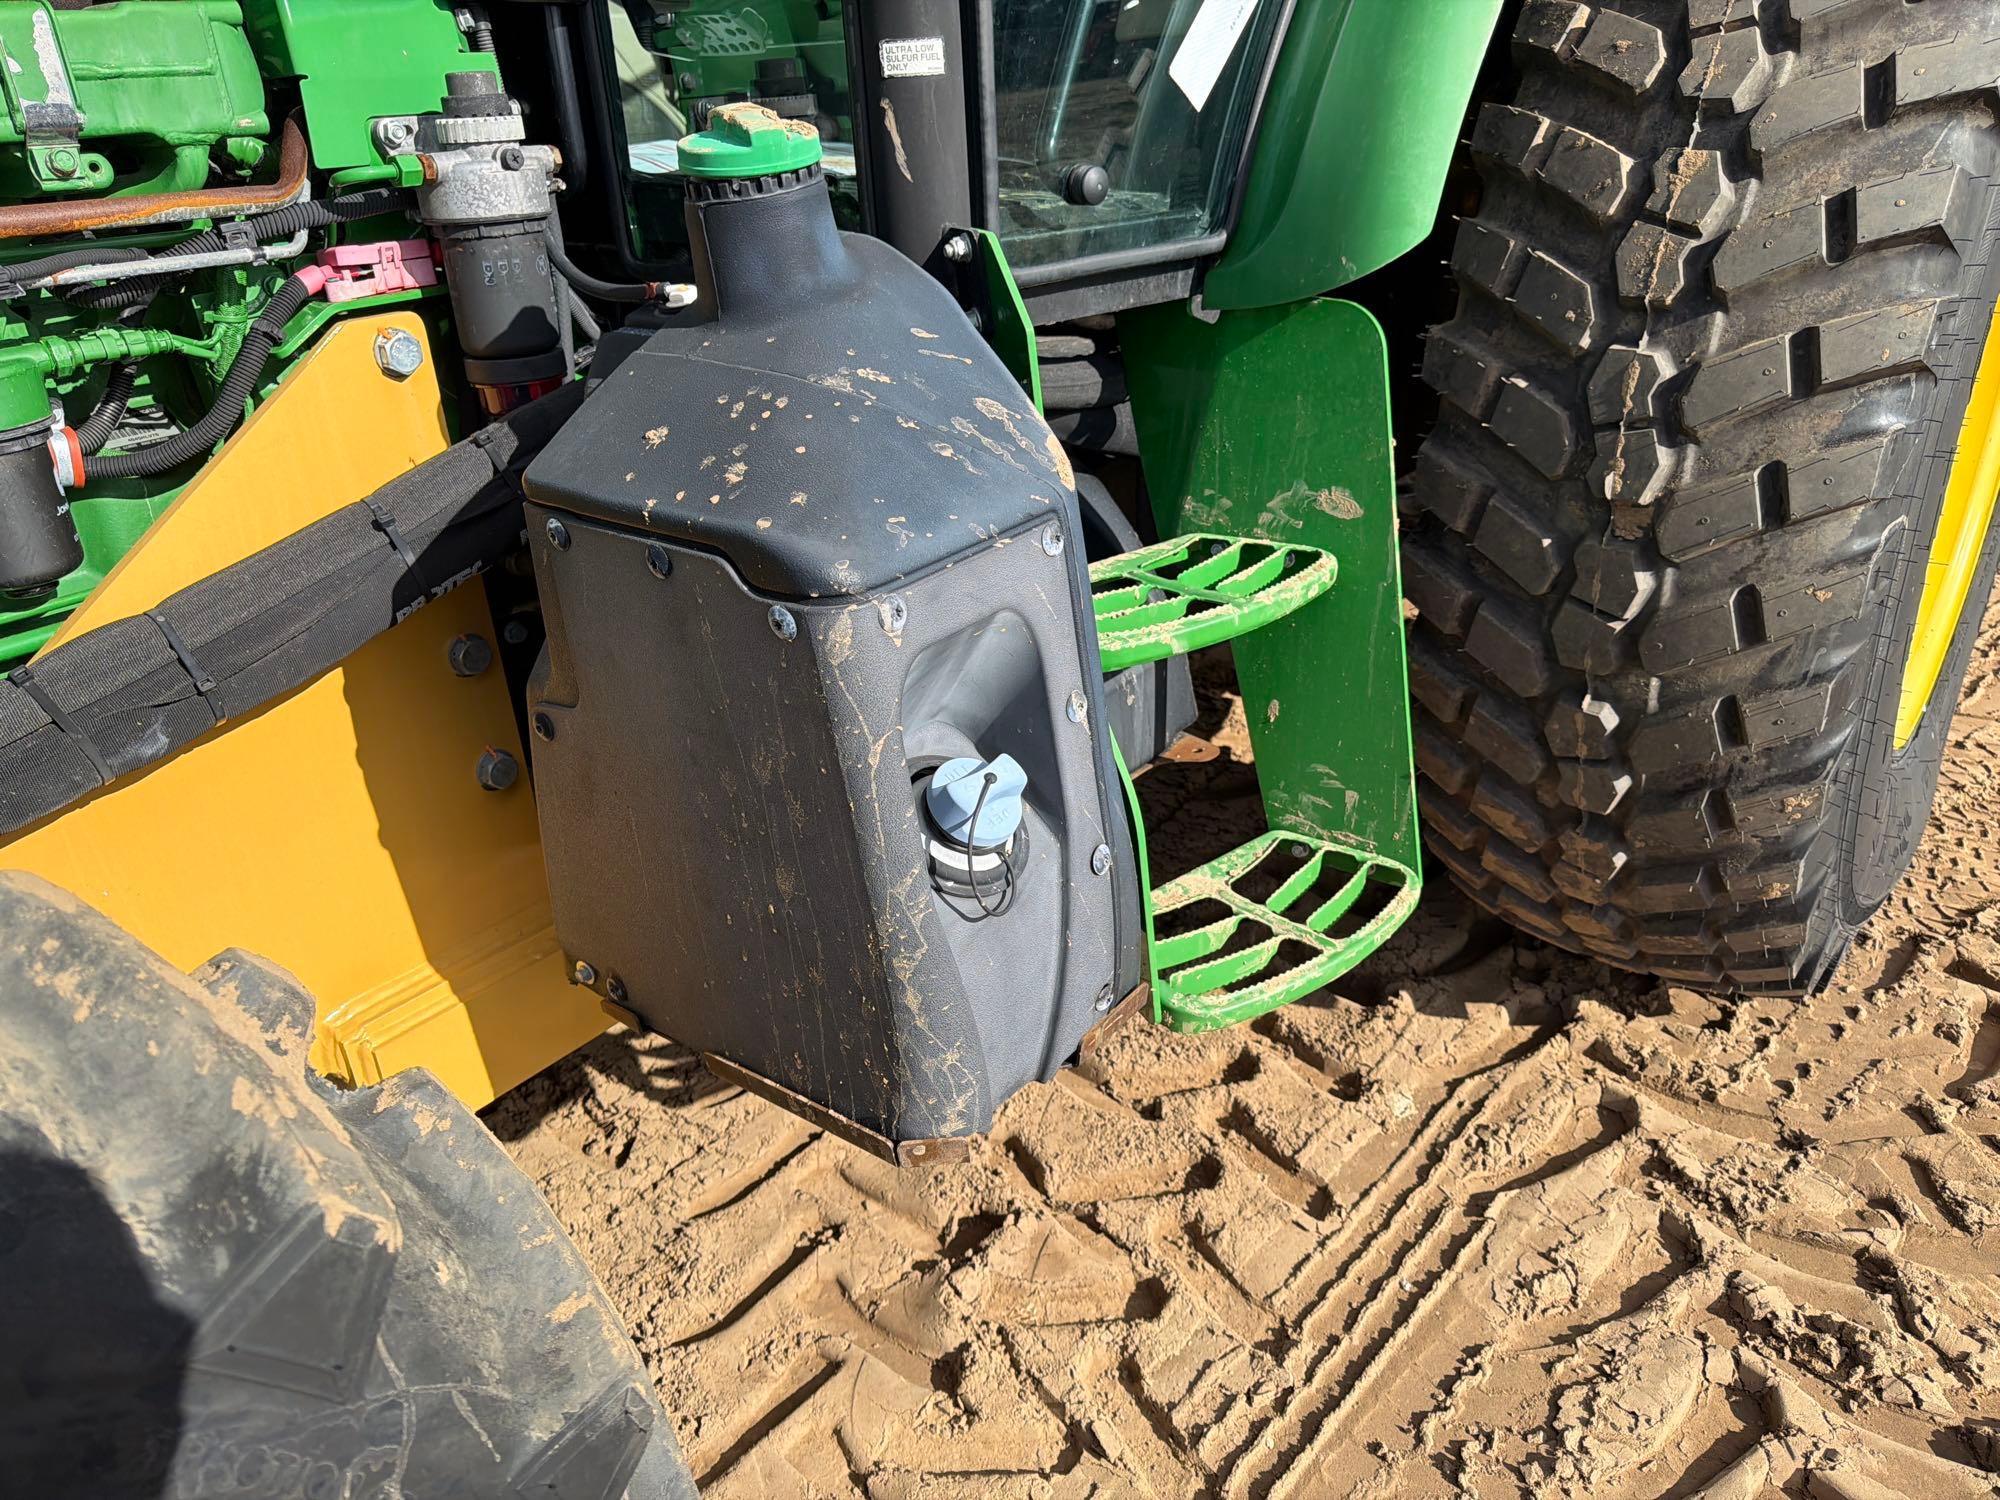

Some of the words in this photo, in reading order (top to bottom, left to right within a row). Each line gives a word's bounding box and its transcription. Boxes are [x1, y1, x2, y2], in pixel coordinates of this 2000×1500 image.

[885, 45, 913, 55] ULTRA
[915, 44, 935, 53] LOW
[885, 53, 918, 64] SULFUR
[920, 52, 941, 61] FUEL
[886, 62, 909, 72] ONLY
